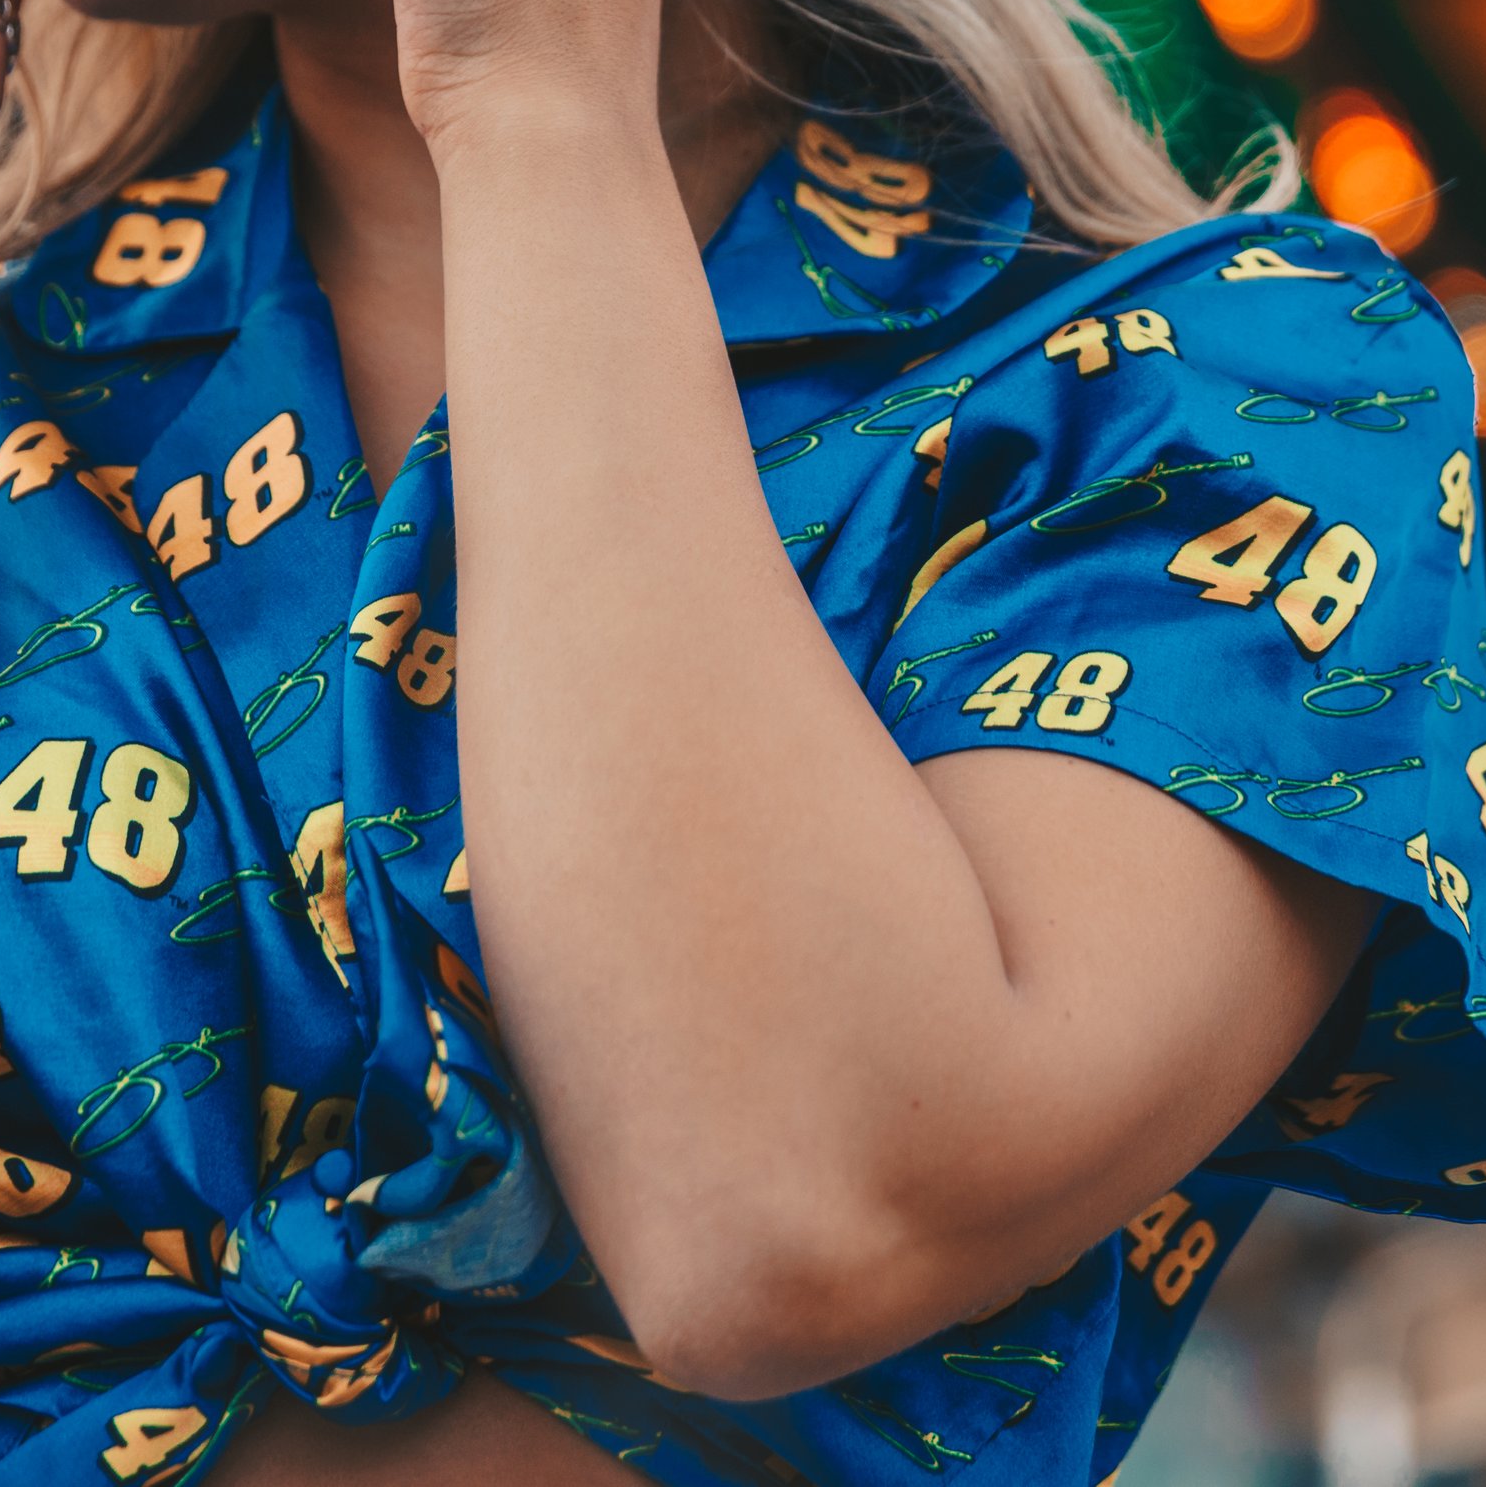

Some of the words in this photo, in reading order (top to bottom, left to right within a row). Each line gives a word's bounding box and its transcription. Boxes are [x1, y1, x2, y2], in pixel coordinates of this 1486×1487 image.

[146, 413, 305, 581] 48
[1168, 496, 1377, 652] 48
[350, 592, 456, 706] 48
[964, 653, 1128, 731] 48
[1126, 1192, 1216, 1306] 48
[104, 1407, 209, 1482] 4
